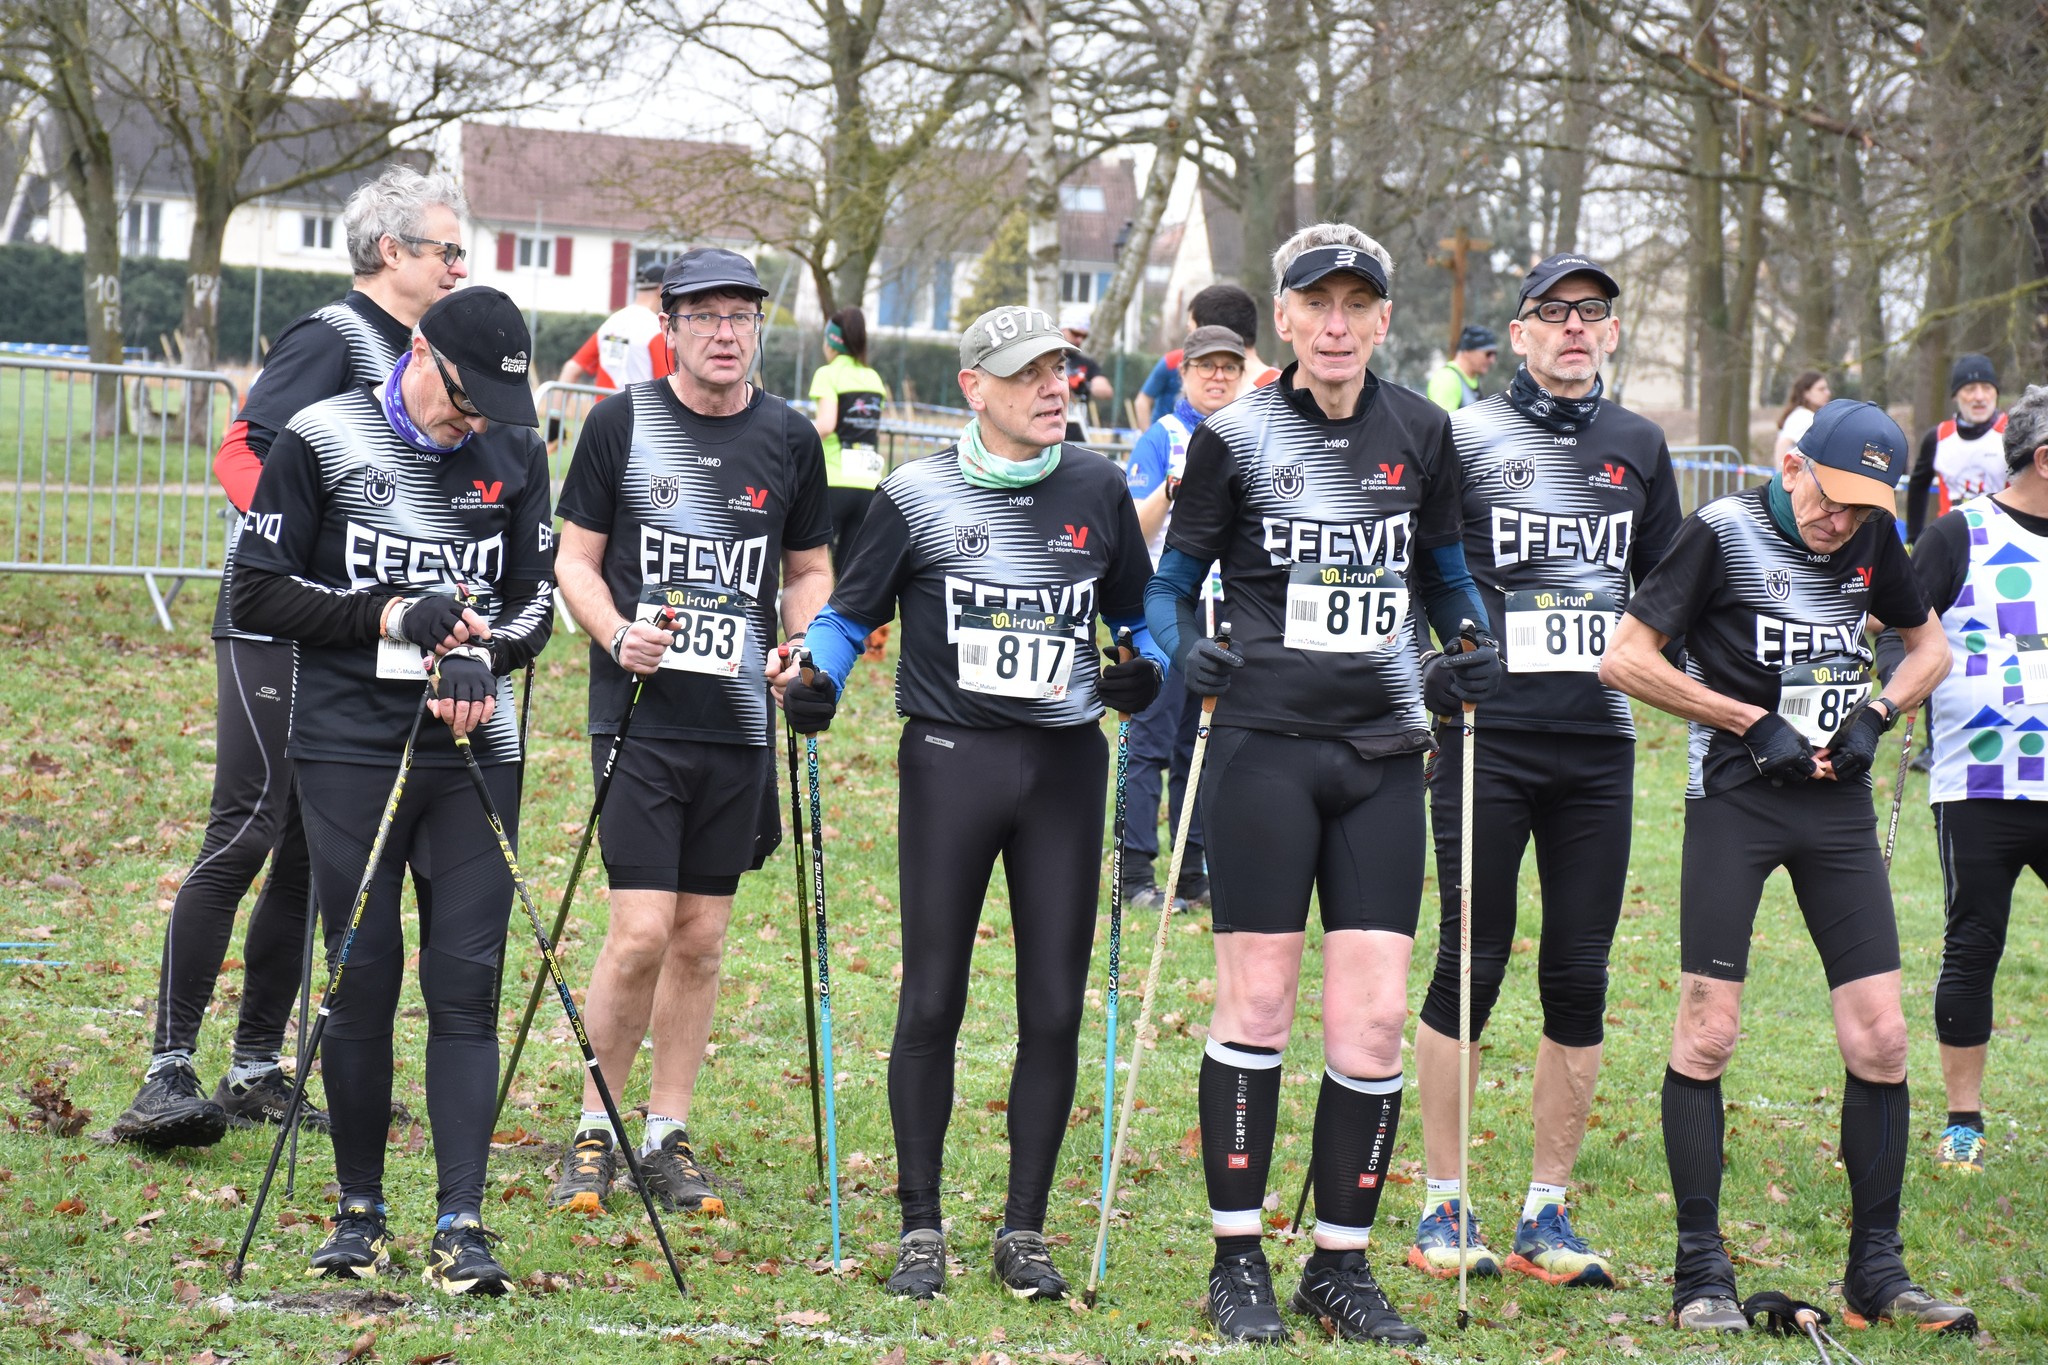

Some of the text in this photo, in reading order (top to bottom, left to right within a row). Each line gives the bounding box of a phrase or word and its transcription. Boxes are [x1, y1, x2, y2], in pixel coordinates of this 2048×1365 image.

[89, 273, 121, 303] 10
[984, 309, 1051, 349] 1977
[501, 362, 527, 374] GEOFF
[1324, 438, 1350, 449] MAKO
[1554, 437, 1578, 446] MAKO
[416, 453, 441, 463] MAKO
[697, 456, 722, 468] MAKO
[1504, 457, 1534, 472] EFCVO
[366, 467, 397, 486] EFCVO
[1273, 463, 1304, 479] EFCVO
[1588, 475, 1611, 483] d'oise
[651, 475, 679, 489] EFCVO
[451, 496, 482, 504] d'oise
[465, 489, 482, 497] val
[1008, 496, 1034, 507] MAKO
[728, 499, 752, 507] d'oise
[956, 522, 988, 540] EFCVO
[1059, 533, 1072, 541] val
[1491, 506, 1634, 572] EFCVO
[1263, 511, 1412, 573] EFCVO
[345, 520, 504, 591] EFCVO
[640, 524, 769, 600] EFCVO
[1806, 554, 1831, 563] MAKO
[1342, 568, 1377, 585] i-run
[1851, 575, 1864, 583] val
[686, 591, 719, 610] i-run
[1556, 592, 1587, 608] i-run
[1012, 613, 1046, 632] i-run
[1326, 590, 1397, 636] 815
[670, 611, 737, 660] 853
[1545, 612, 1606, 657] 818
[996, 634, 1066, 684] 817
[1833, 667, 1860, 682] i-run
[603, 735, 621, 778] LEKI
[386, 776, 406, 823] LEKI
[1885, 811, 1899, 858] GUIDETTI
[499, 840, 524, 883] LEKI
[1112, 849, 1121, 906] GUIDETTI
[814, 861, 824, 916] GUIDETTI
[1160, 895, 1175, 945] GUIDETTI
[1235, 1073, 1249, 1150] COMPRESSPORT
[1368, 1098, 1392, 1171] COMPRESSPORT
